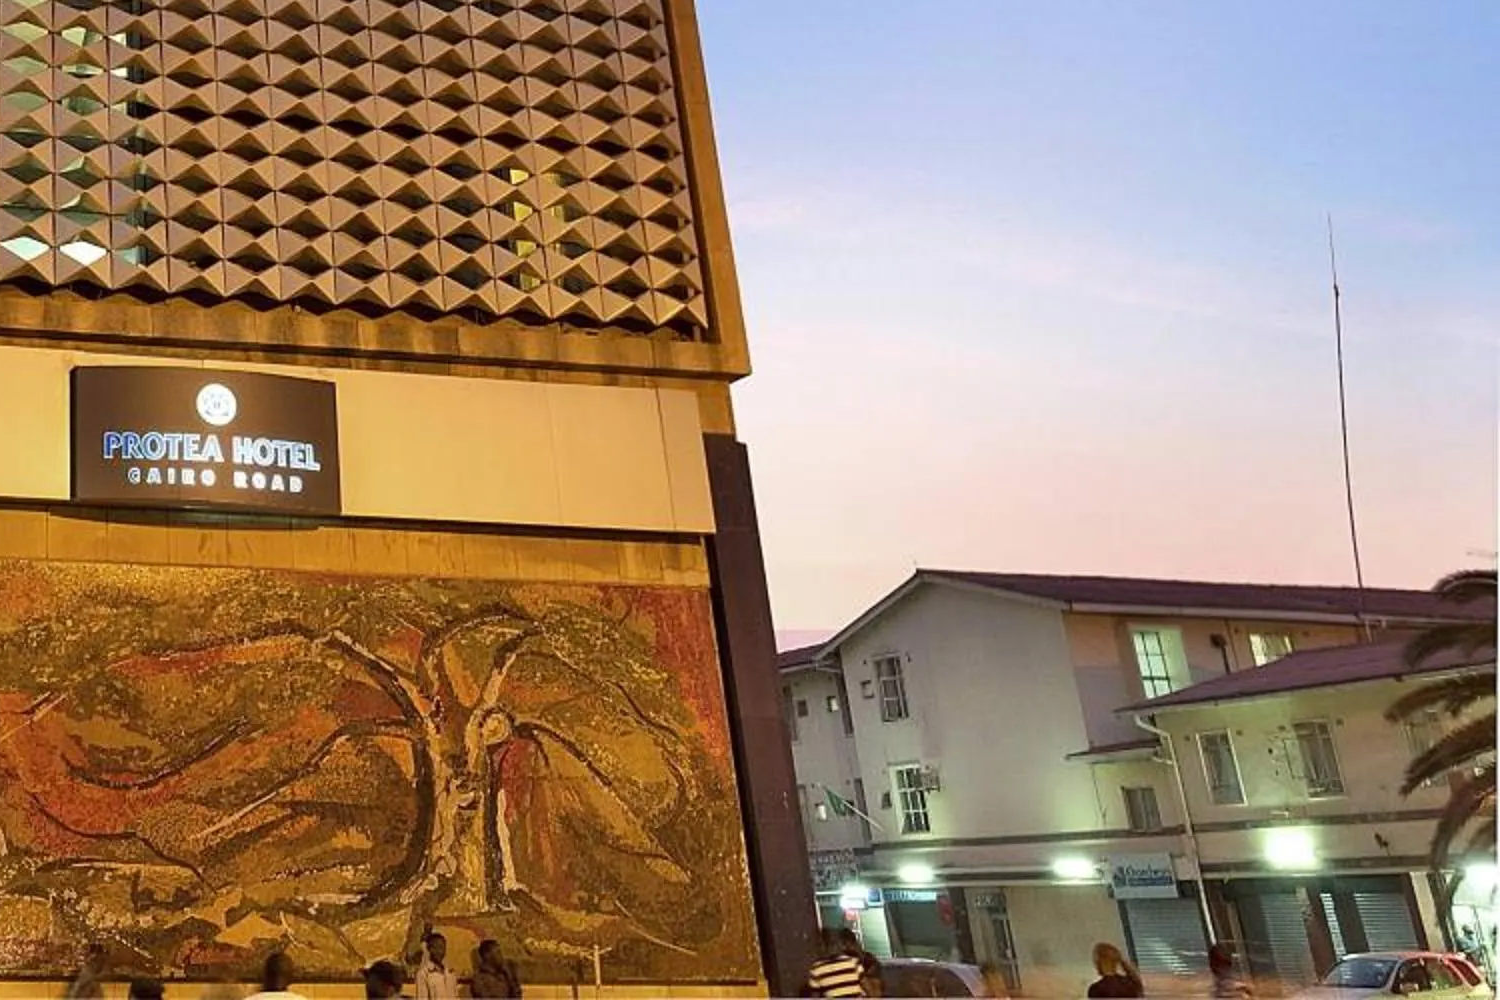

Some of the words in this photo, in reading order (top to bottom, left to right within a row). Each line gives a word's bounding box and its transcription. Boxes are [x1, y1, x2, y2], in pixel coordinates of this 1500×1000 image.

[103, 431, 224, 462] PROTEA
[232, 436, 321, 471] HOTEL
[128, 467, 216, 486] CAIRO
[233, 471, 303, 493] ROAD
